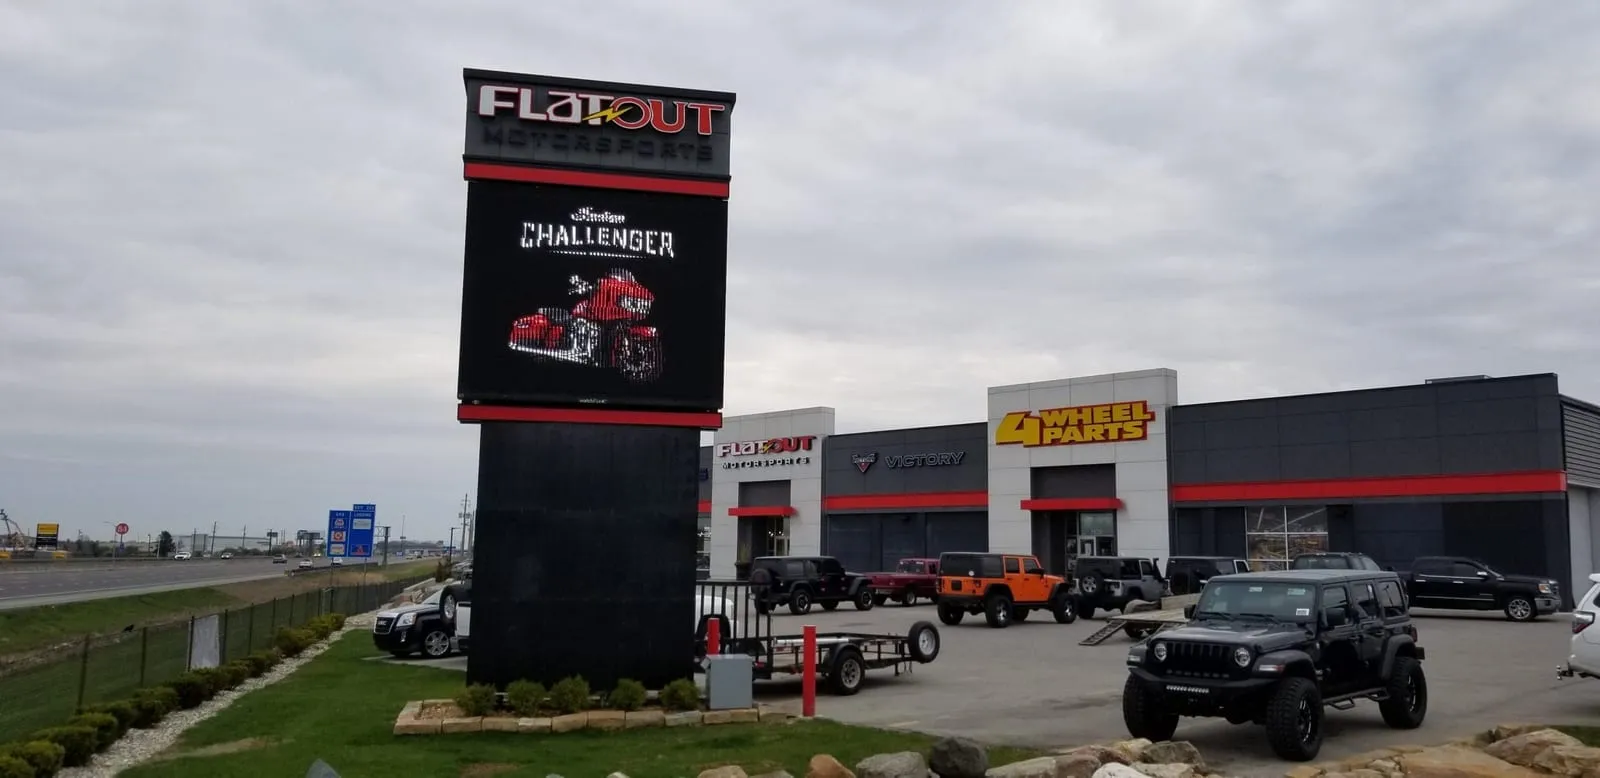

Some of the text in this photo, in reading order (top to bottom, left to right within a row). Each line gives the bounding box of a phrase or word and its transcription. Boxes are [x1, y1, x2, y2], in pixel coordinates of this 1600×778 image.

[483, 126, 713, 161] MOTORSPORTS
[520, 221, 675, 258] CHALLENGER
[995, 401, 1153, 448] 4 WHEEL
[1042, 420, 1144, 445] PARTS
[722, 457, 811, 470] MOTORSPORTS
[885, 451, 965, 468] VICTORY
